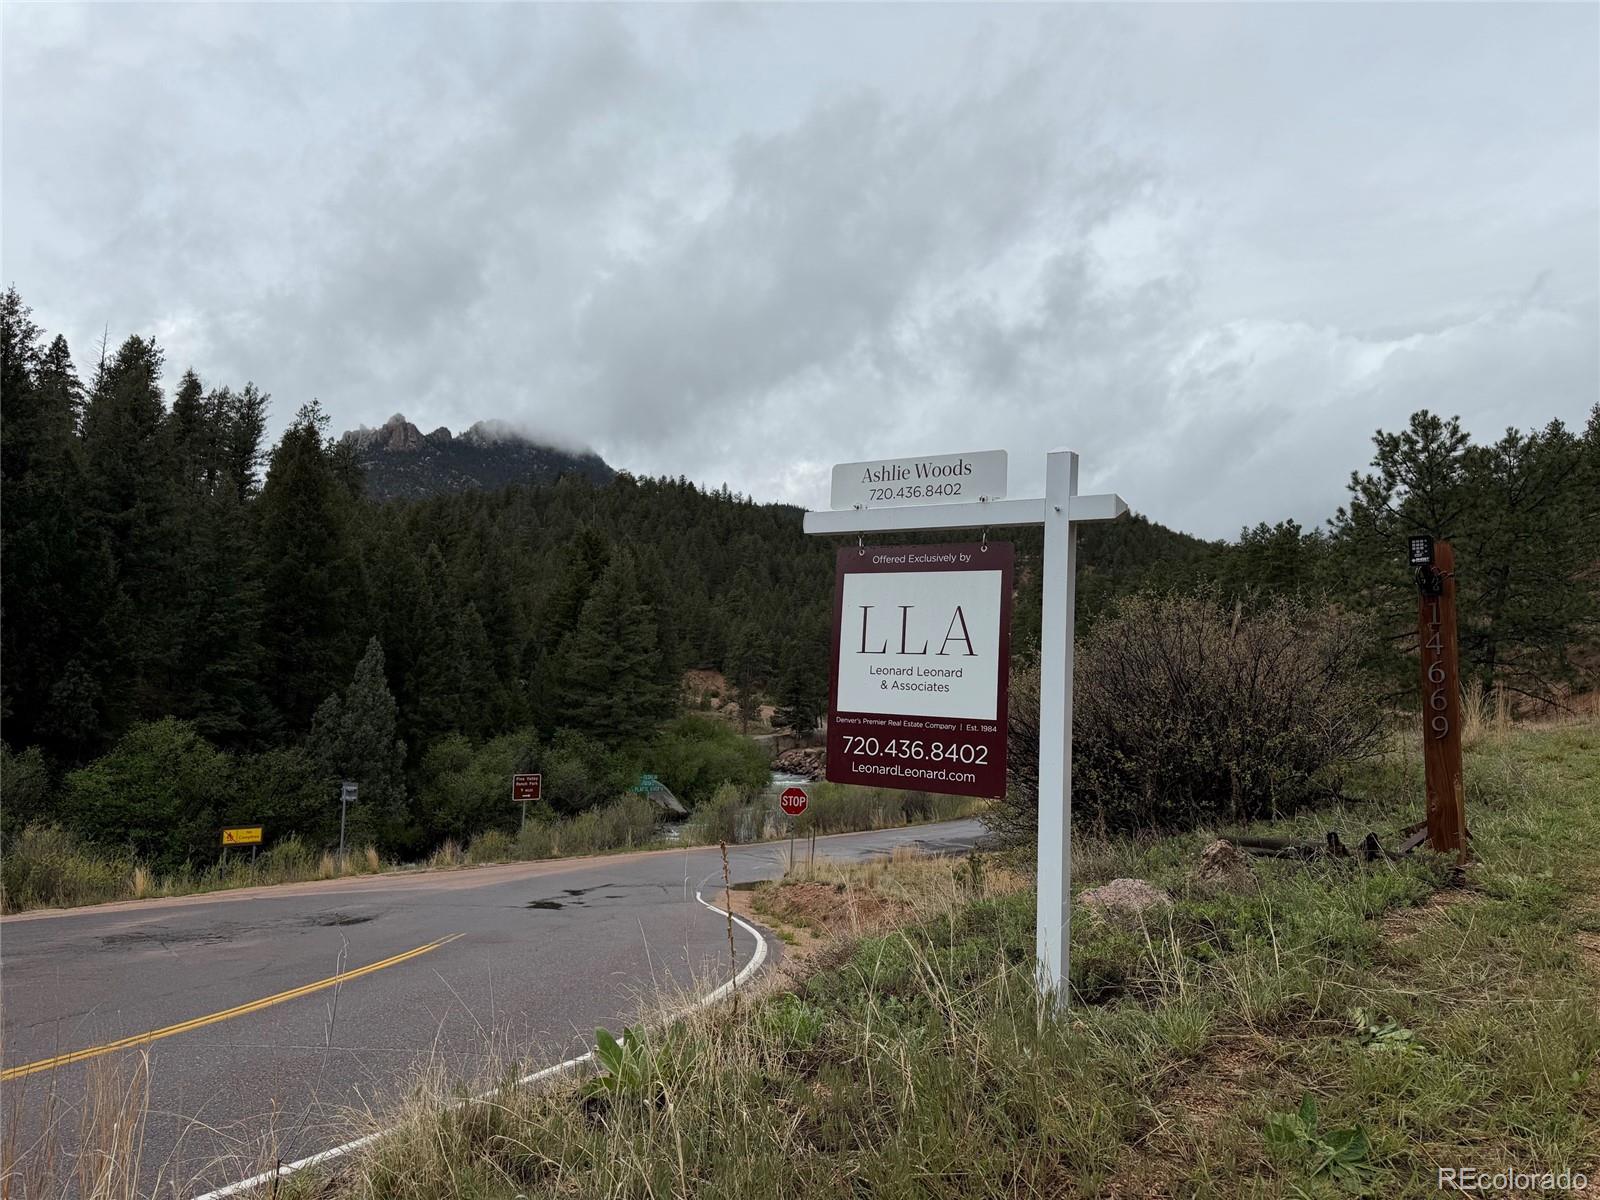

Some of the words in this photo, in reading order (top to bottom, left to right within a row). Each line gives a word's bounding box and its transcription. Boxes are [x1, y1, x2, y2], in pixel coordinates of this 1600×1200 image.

[861, 465, 911, 484] Ashlie
[915, 459, 972, 479] Woods
[869, 482, 962, 501] 720.436.8402
[872, 555, 906, 564] Offered
[908, 553, 956, 563] Exclusively
[959, 553, 972, 563] by
[856, 605, 979, 657] LLA
[869, 665, 914, 677] Leonard
[916, 667, 963, 678] Leonard
[1425, 602, 1449, 740] 14669
[880, 680, 888, 690] &
[891, 680, 950, 693] Associates
[836, 716, 862, 725] Denver's
[862, 717, 887, 726] Premier
[887, 719, 902, 727] Real
[903, 720, 924, 729] Estate
[924, 721, 957, 732] Company
[966, 724, 979, 732] Est.
[980, 725, 997, 733] 1984
[842, 735, 989, 766] 720.436.8402
[852, 761, 976, 784] LeonardLeonard.com
[782, 795, 806, 807] STOP
